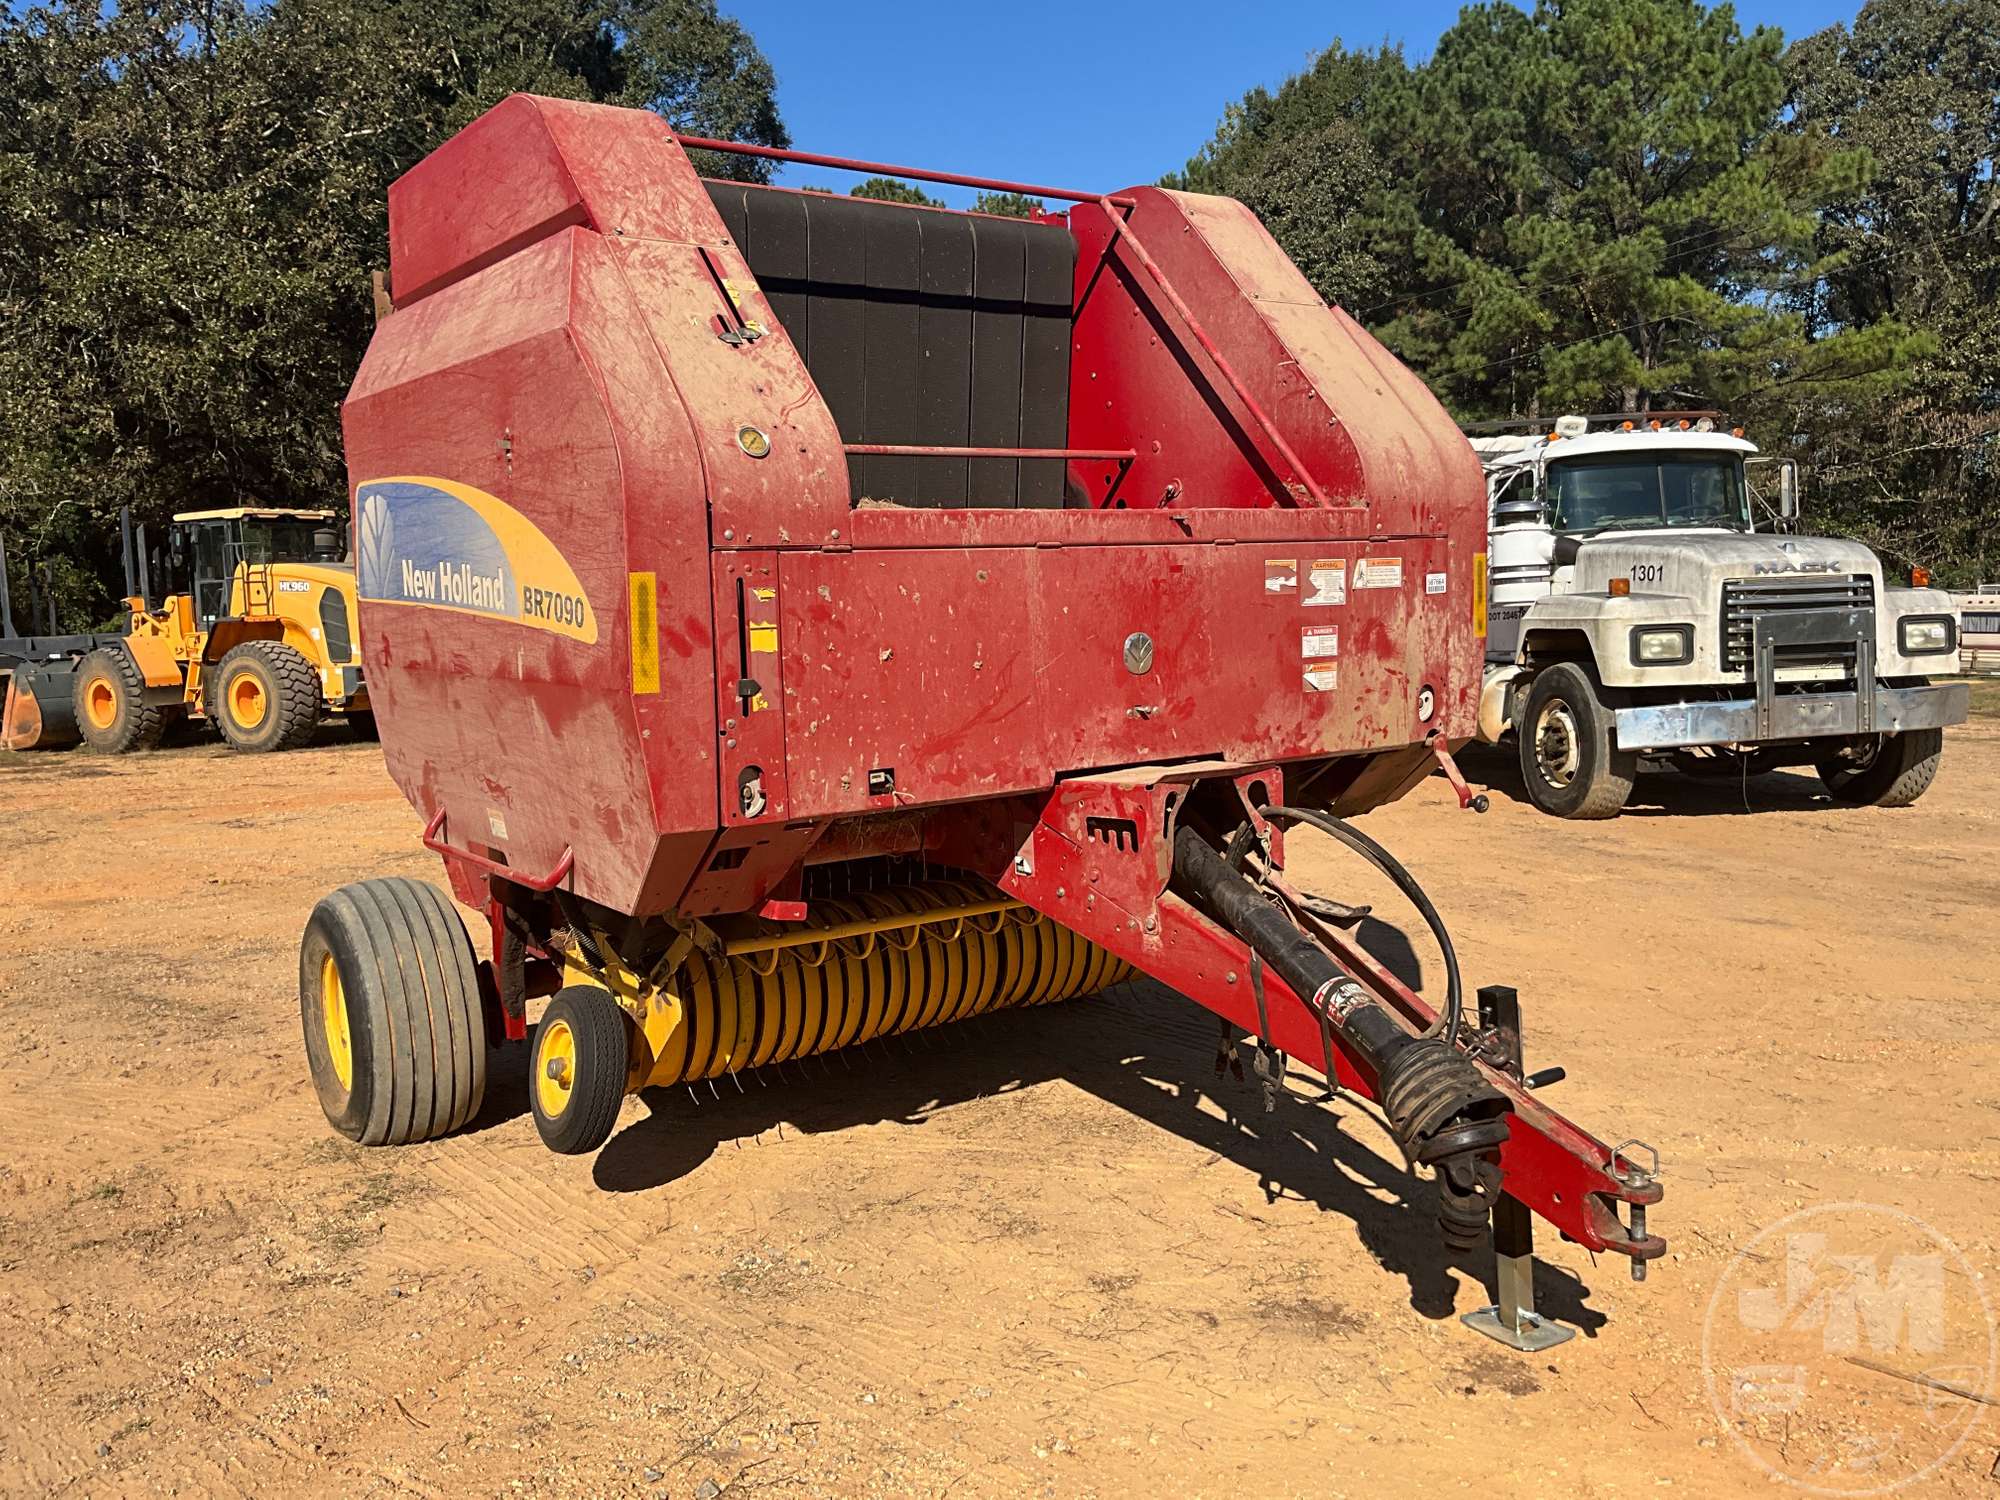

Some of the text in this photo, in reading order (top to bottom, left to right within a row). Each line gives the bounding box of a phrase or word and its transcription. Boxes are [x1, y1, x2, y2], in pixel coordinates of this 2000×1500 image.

[279, 580, 310, 592] HL960
[402, 559, 505, 610] New Holland
[1630, 564, 1664, 582] 1301
[523, 586, 585, 628] BR7090
